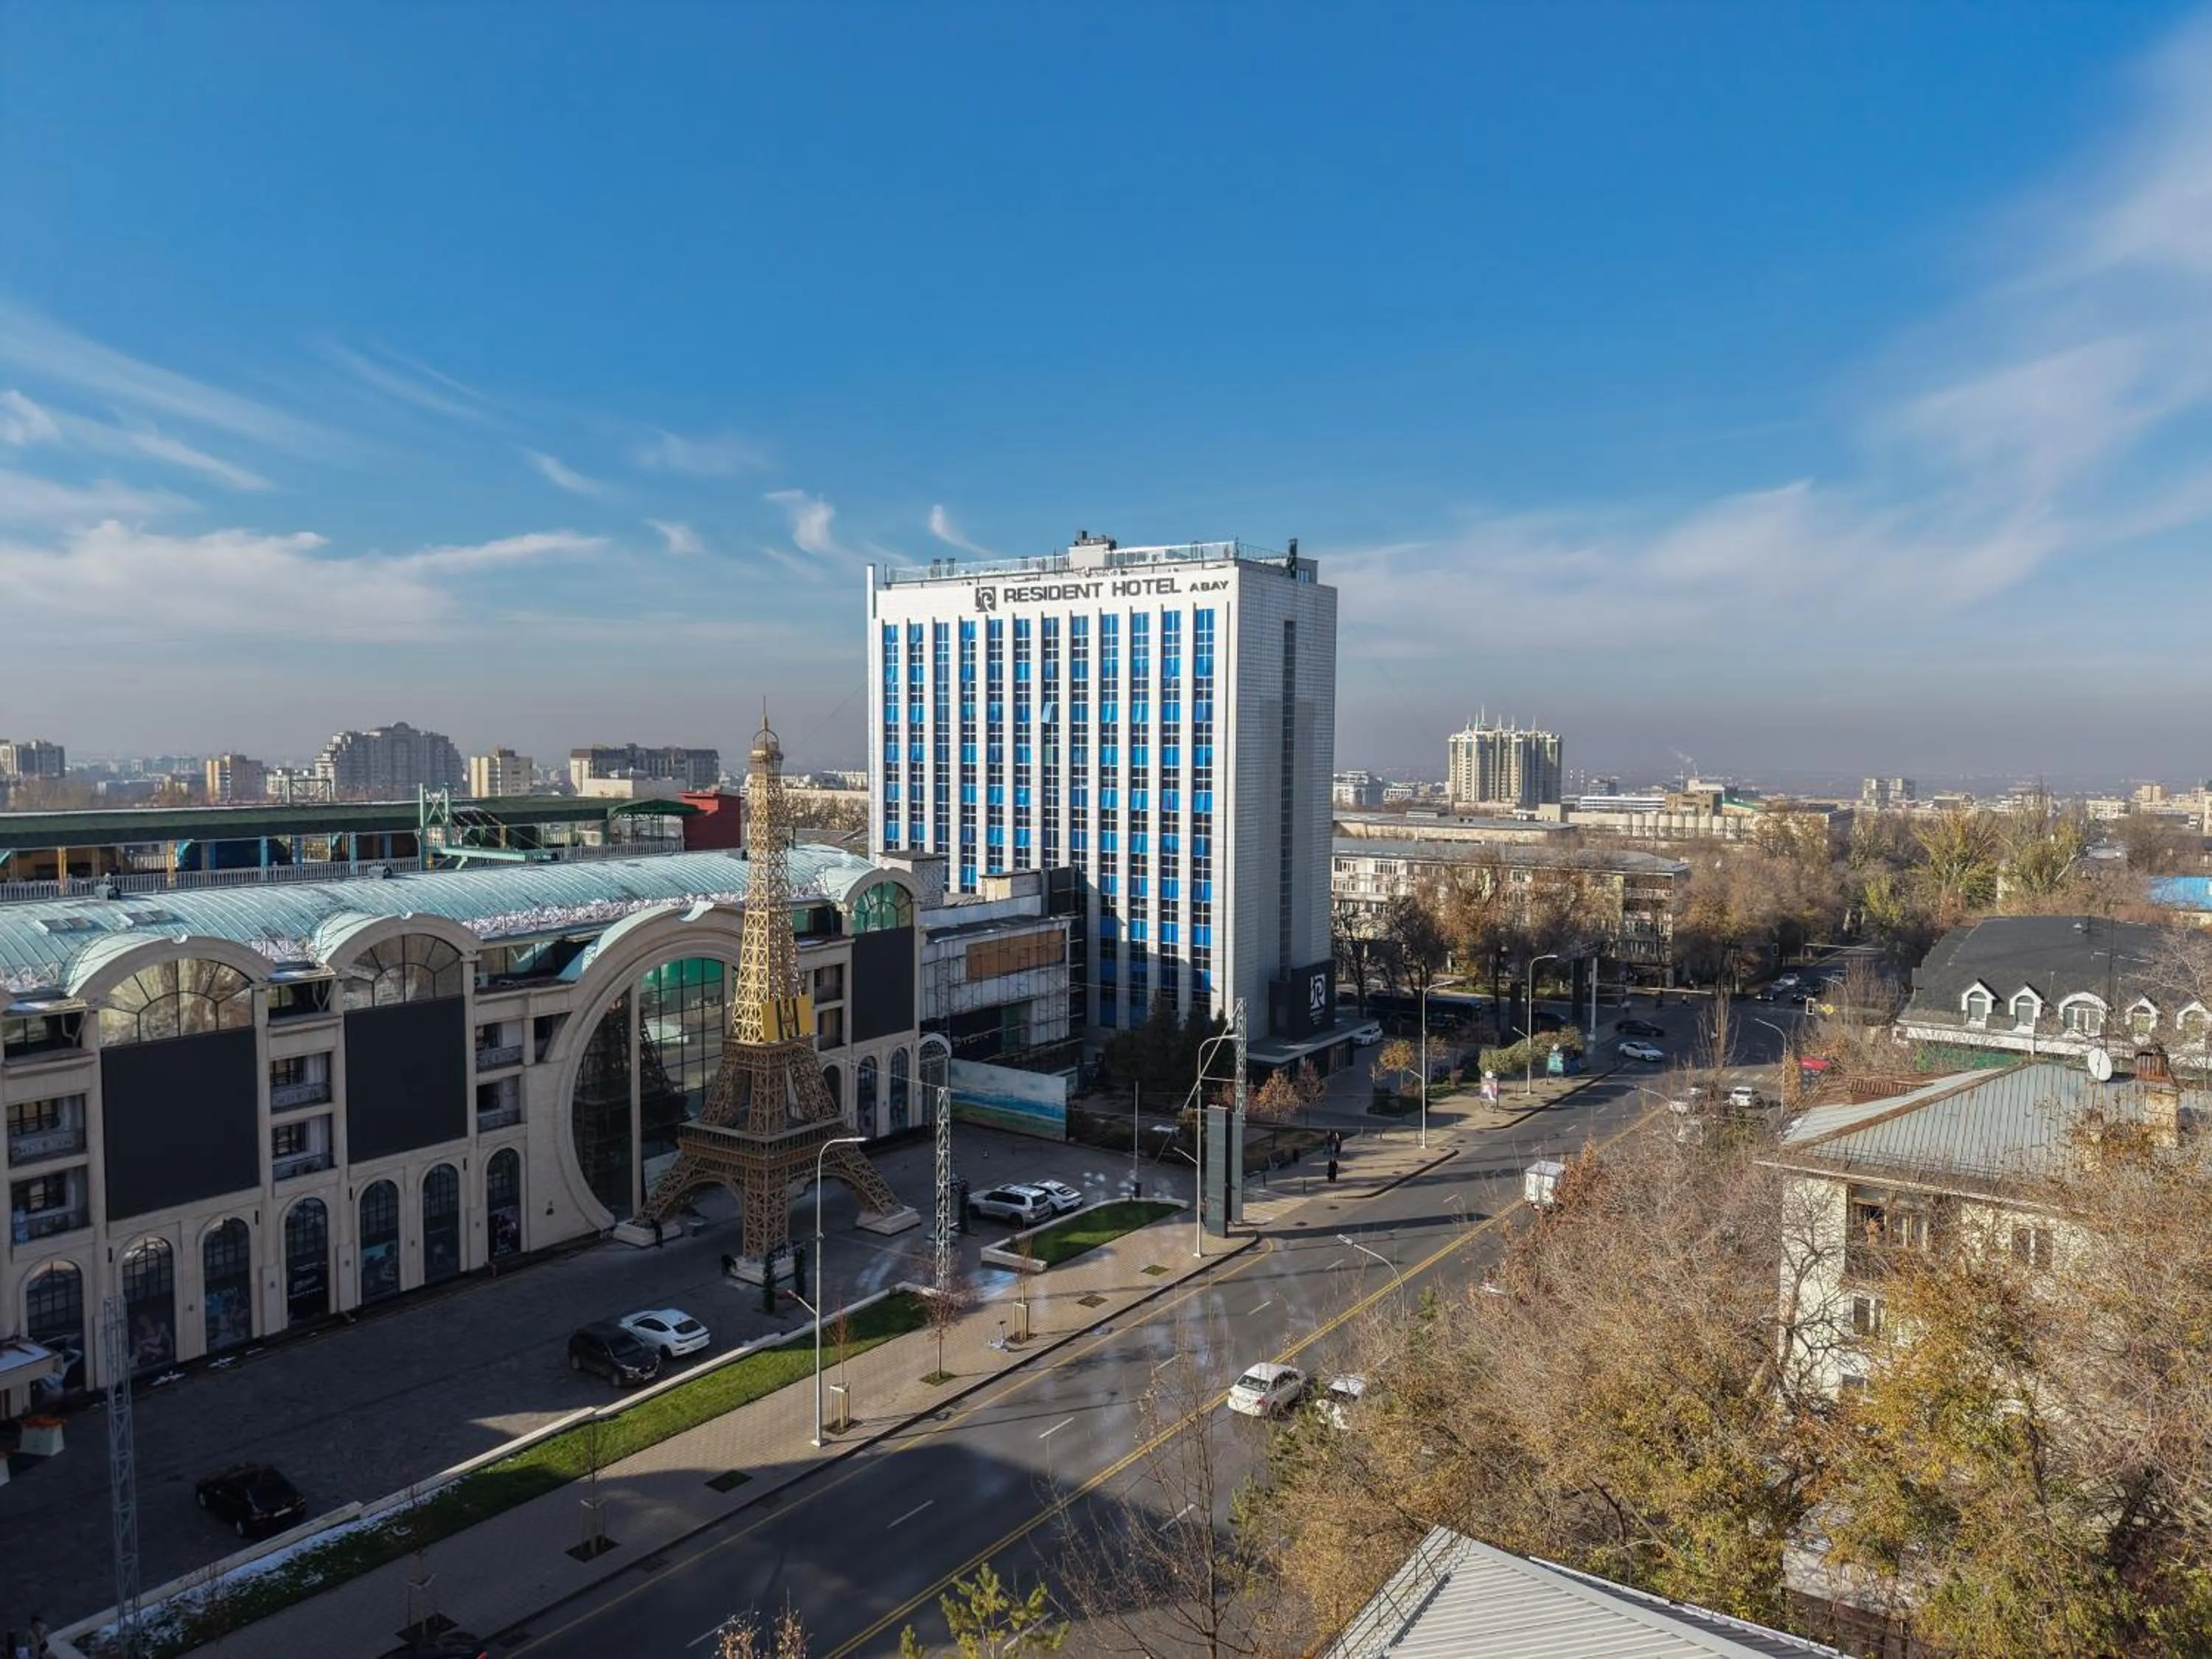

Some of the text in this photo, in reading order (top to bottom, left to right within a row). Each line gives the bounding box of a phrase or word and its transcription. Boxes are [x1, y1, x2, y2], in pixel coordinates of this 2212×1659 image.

[1004, 582, 1104, 603] RESIDENT
[1111, 577, 1182, 597] HOTEL
[1189, 580, 1229, 592] ABAY
